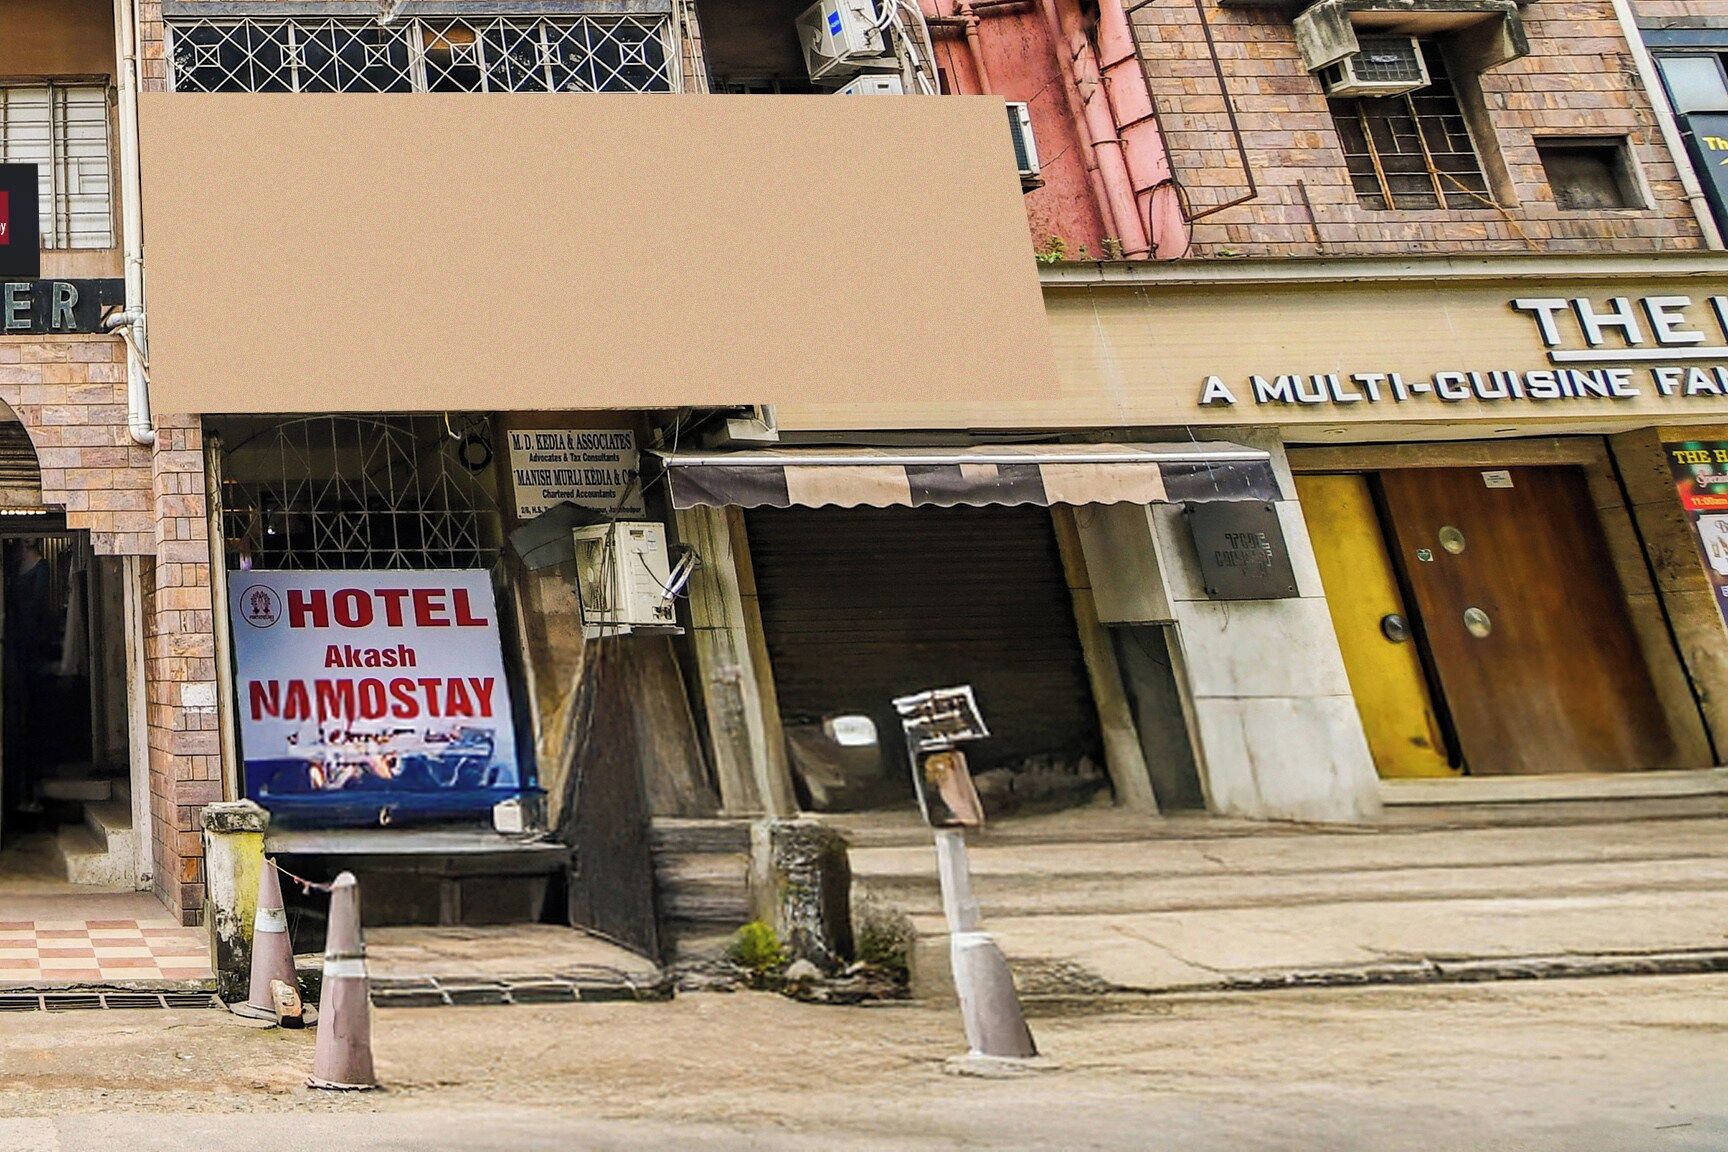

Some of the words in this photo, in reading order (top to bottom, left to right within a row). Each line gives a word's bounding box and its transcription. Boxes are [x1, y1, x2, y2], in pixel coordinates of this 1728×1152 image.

[1509, 295, 1707, 347] THE
[1198, 374, 1238, 406] A
[1249, 368, 1642, 405] MULTI-CUISINE
[512, 433, 523, 450] M.
[524, 433, 535, 450] D.
[536, 433, 565, 449] KEDIA
[567, 434, 574, 449] &
[576, 433, 632, 450] ASSOCIATES
[529, 452, 562, 462] Advocates
[563, 453, 568, 462] &
[569, 452, 581, 462] Tax
[583, 452, 620, 462] Consultants
[1672, 450, 1712, 464] THE
[516, 469, 552, 486] MANISH
[554, 469, 583, 486] MURLI
[585, 469, 614, 485] KEDIA
[614, 469, 621, 485] &
[542, 489, 574, 499] Chartered
[576, 489, 616, 499] Accountants
[286, 588, 489, 628] HOTEL
[324, 644, 417, 668] Akash
[248, 677, 495, 722] NAMOSTAY
